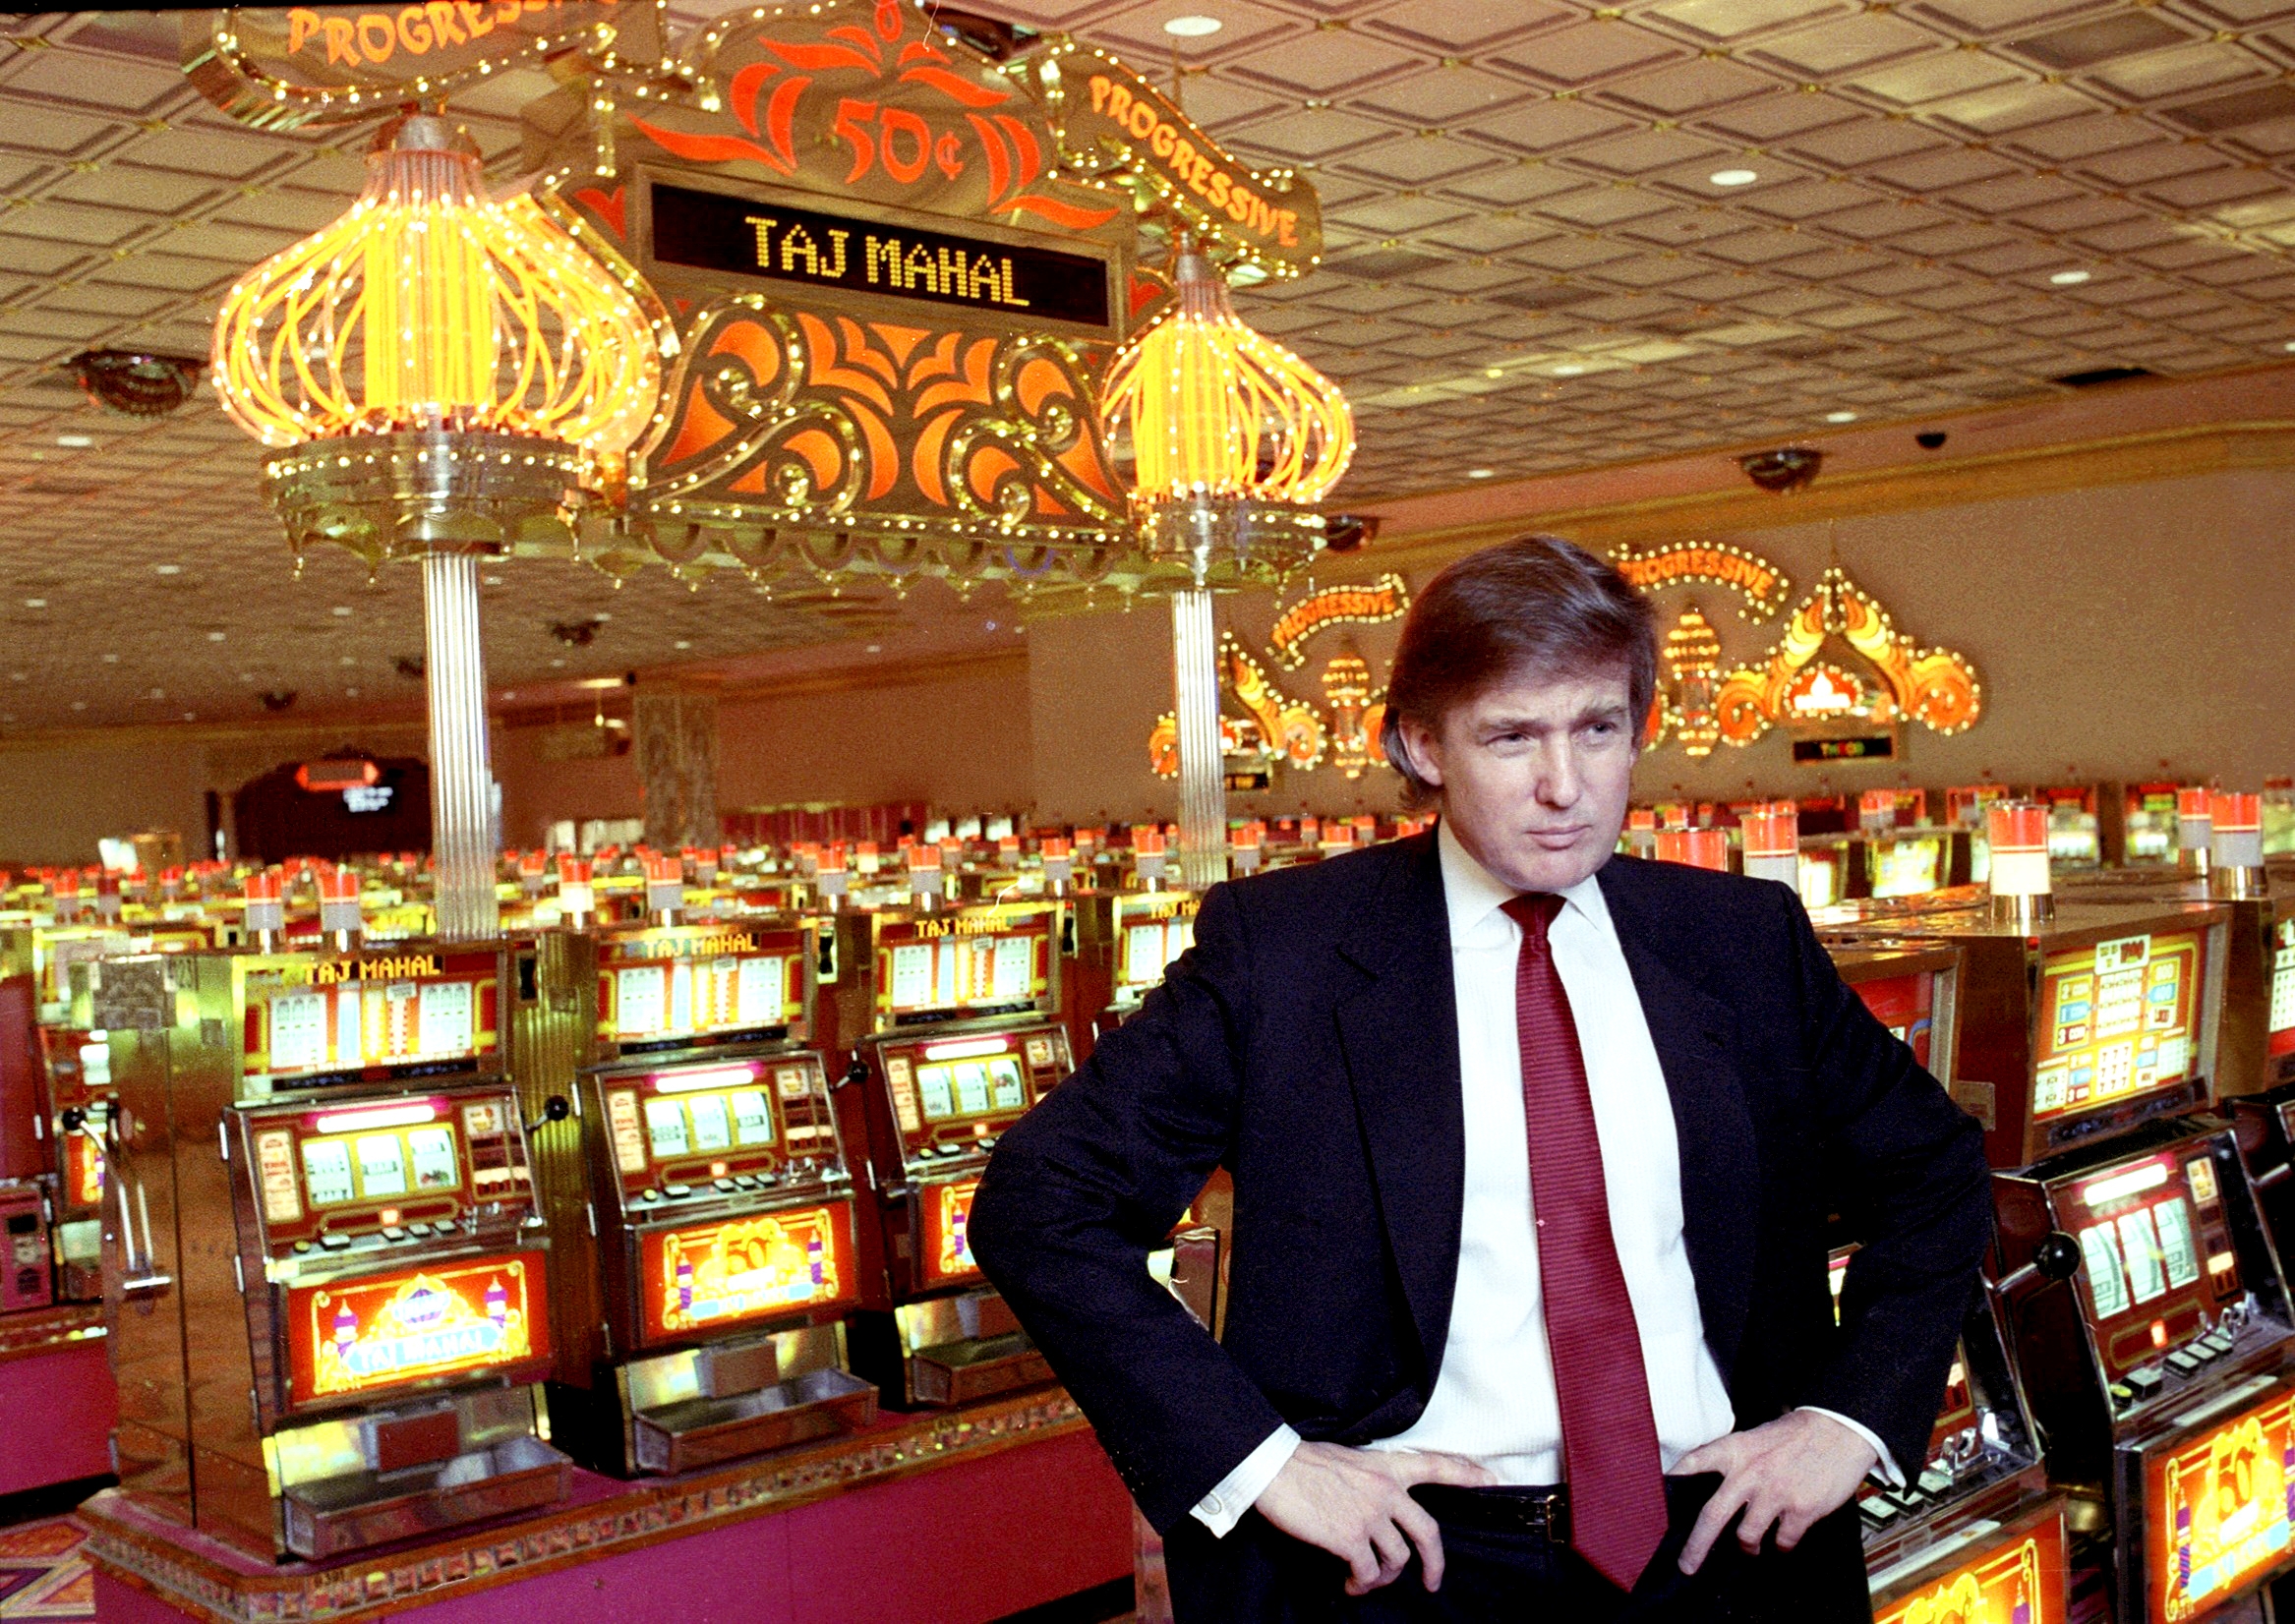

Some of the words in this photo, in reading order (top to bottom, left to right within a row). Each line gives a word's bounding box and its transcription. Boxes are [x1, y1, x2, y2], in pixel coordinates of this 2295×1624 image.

[285, 0, 619, 67] PROGRES
[835, 98, 964, 185] 50¢
[1089, 75, 1299, 247] PROGRESSIVE
[744, 215, 850, 278] TAJ
[865, 235, 1030, 307] MAHAL
[644, 939, 686, 958] TAJ
[690, 933, 758, 956] MAHAL
[915, 918, 951, 938] TAJ
[955, 915, 1011, 935] MAHAL
[302, 959, 352, 985] TAJ
[359, 955, 441, 980] MAHAL
